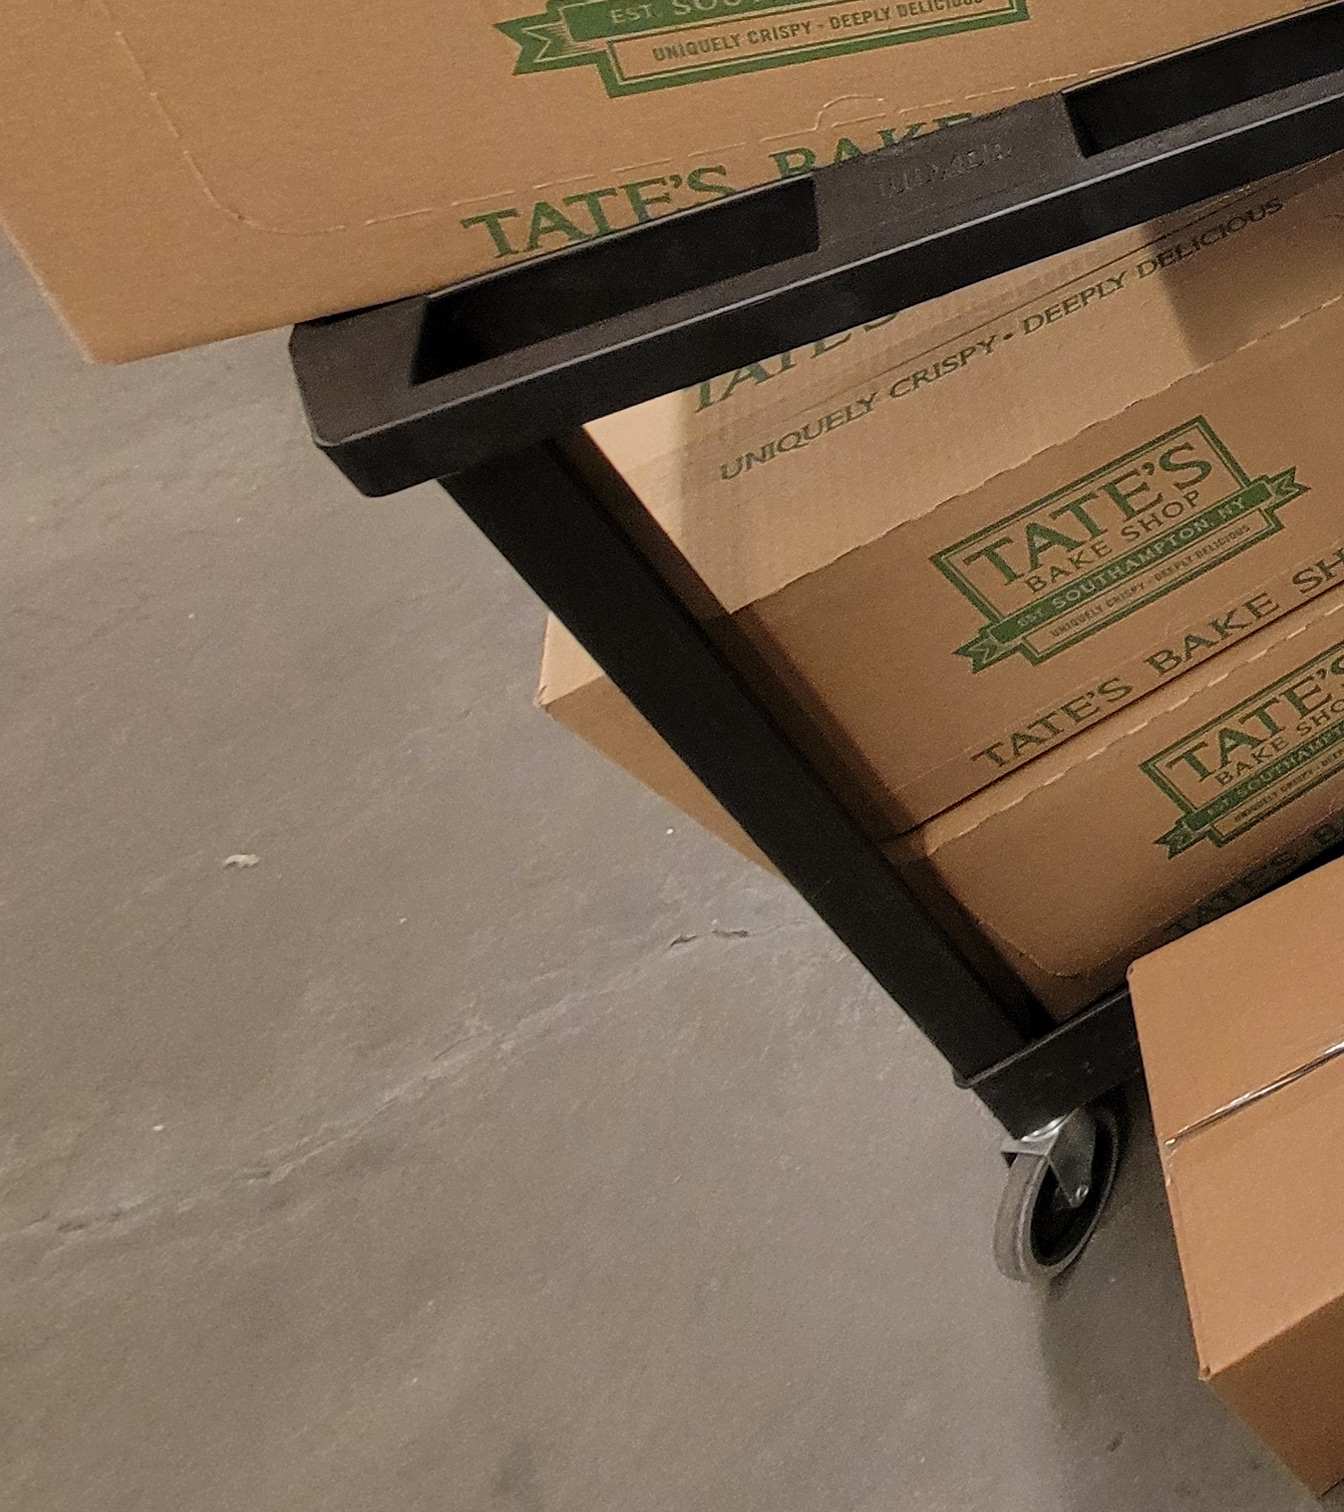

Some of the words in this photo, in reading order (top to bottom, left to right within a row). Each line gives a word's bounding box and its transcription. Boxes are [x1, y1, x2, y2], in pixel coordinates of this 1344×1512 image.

[609, 1, 655, 26] EST.
[652, 32, 741, 63] UNIQUELY
[747, 20, 812, 48] CRISPY
[829, 4, 891, 32] DEEPLY
[719, 391, 879, 482] UNIQUELY
[889, 336, 997, 400] CRISPY
[1022, 273, 1128, 337] DEEPLY
[1136, 194, 1286, 281] DELICIOUS
[963, 442, 1212, 585] TATE'S
[1024, 540, 1112, 594] BAKE
[1120, 489, 1200, 544] SHOP
[1220, 497, 1245, 522] NY
[1050, 604, 1104, 639] UNIQUELY
[1106, 582, 1146, 610] CRISPY
[1154, 553, 1195, 583] DEEPLY
[1196, 524, 1251, 562] DELICIOUS
[971, 677, 1133, 768] TATE'S
[1143, 592, 1280, 675] BAKE
[1215, 737, 1289, 786] BAKE
